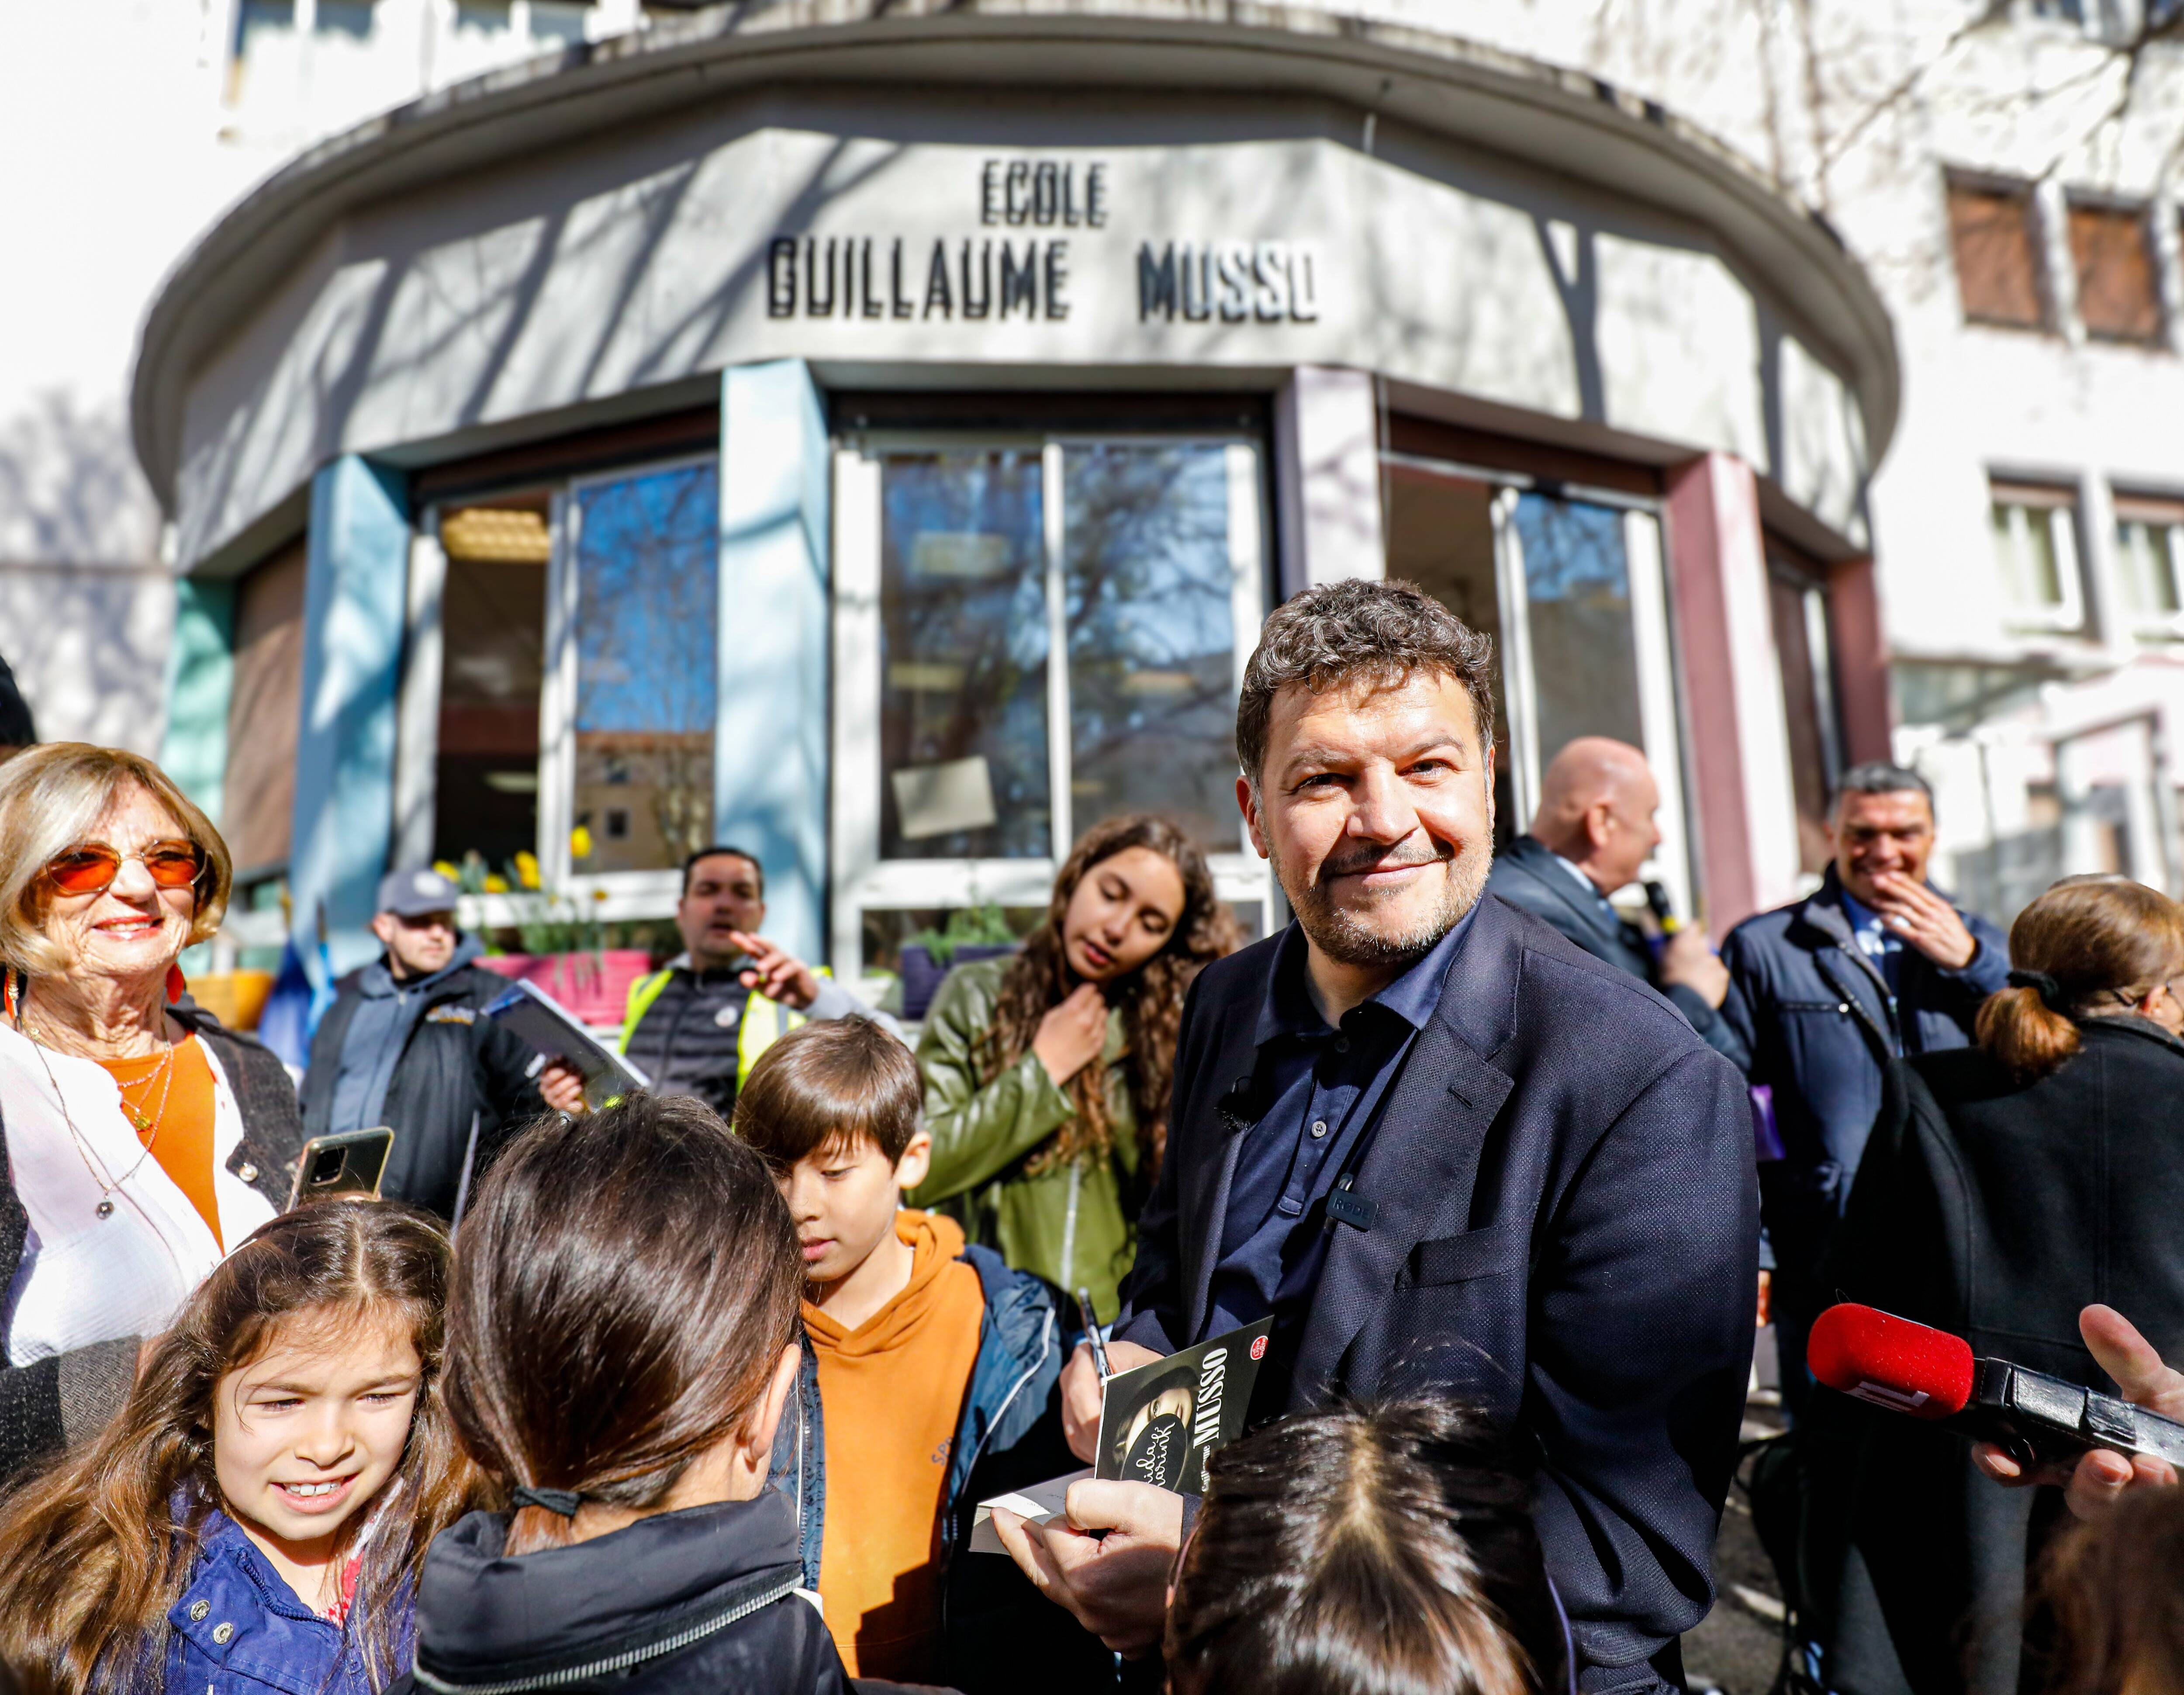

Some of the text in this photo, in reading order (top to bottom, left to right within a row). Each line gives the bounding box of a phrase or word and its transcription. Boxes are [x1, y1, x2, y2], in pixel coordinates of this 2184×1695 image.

[980, 160, 1109, 227] ECOLE
[768, 237, 1319, 323] GUILLAUME MUSSO
[1193, 1347, 1228, 1449] MUSSO
